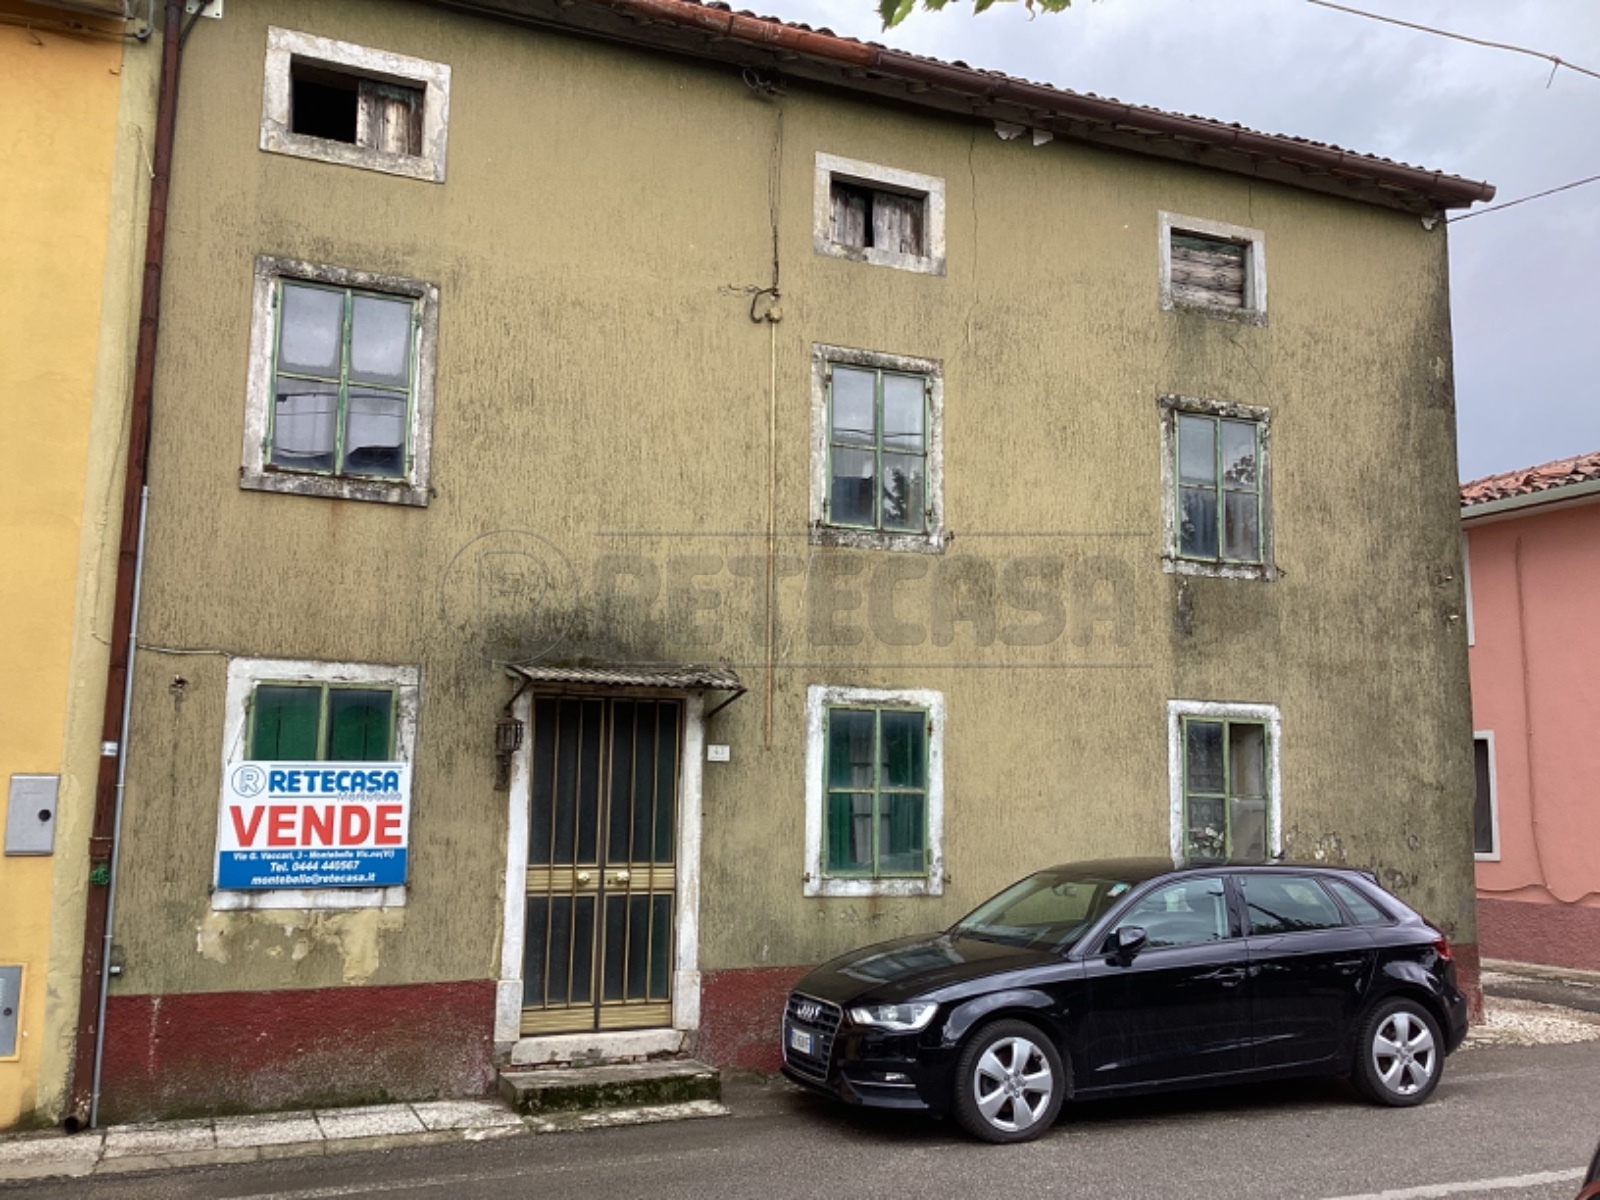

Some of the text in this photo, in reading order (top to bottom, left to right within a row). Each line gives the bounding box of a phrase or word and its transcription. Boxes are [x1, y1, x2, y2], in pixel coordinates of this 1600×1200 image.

[268, 770, 399, 793] RETECASA
[229, 805, 403, 847] VENDE
[233, 852, 248, 861] Via
[309, 850, 354, 859] Montebello
[270, 862, 289, 872] Tel.
[292, 860, 319, 872] 0444
[250, 872, 376, 886] montebello@retecasa.it
